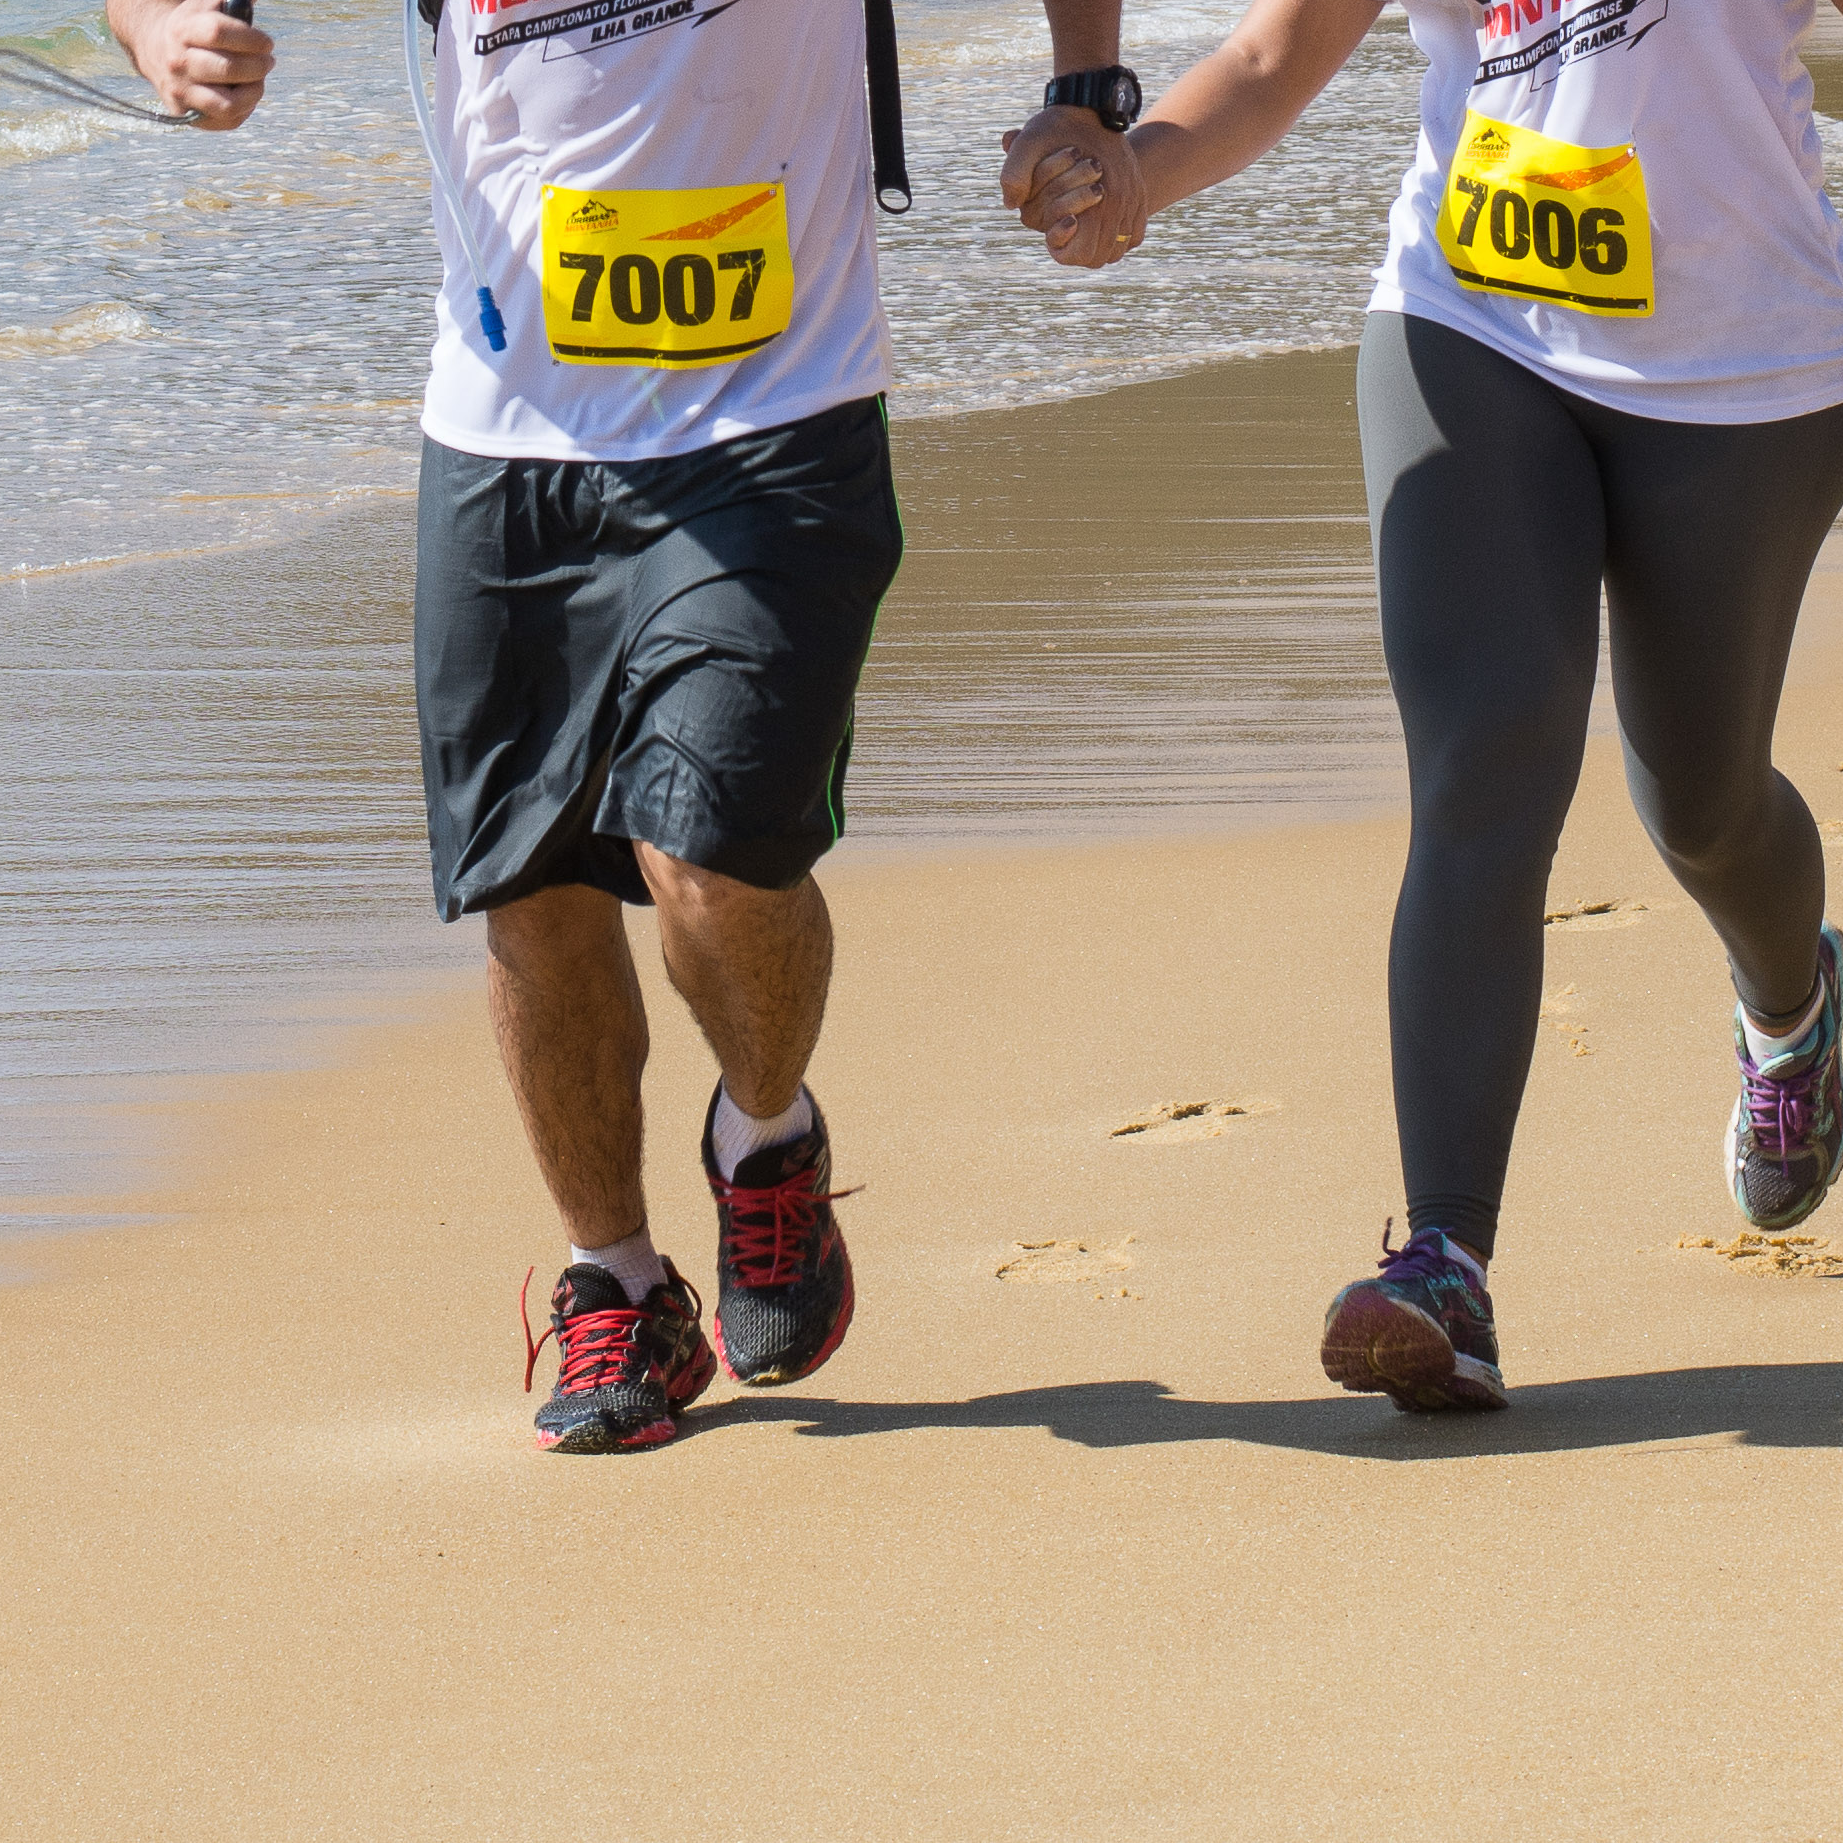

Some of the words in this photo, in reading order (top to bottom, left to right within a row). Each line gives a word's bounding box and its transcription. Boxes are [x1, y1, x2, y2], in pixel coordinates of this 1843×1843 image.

[487, 28, 521, 50] ETAPA
[525, 1, 609, 37] CAMPEONATO
[591, 19, 626, 44] ILHA
[1574, 19, 1628, 55] GRANDE
[1456, 174, 1628, 276] 7006
[559, 248, 767, 327] 7007
